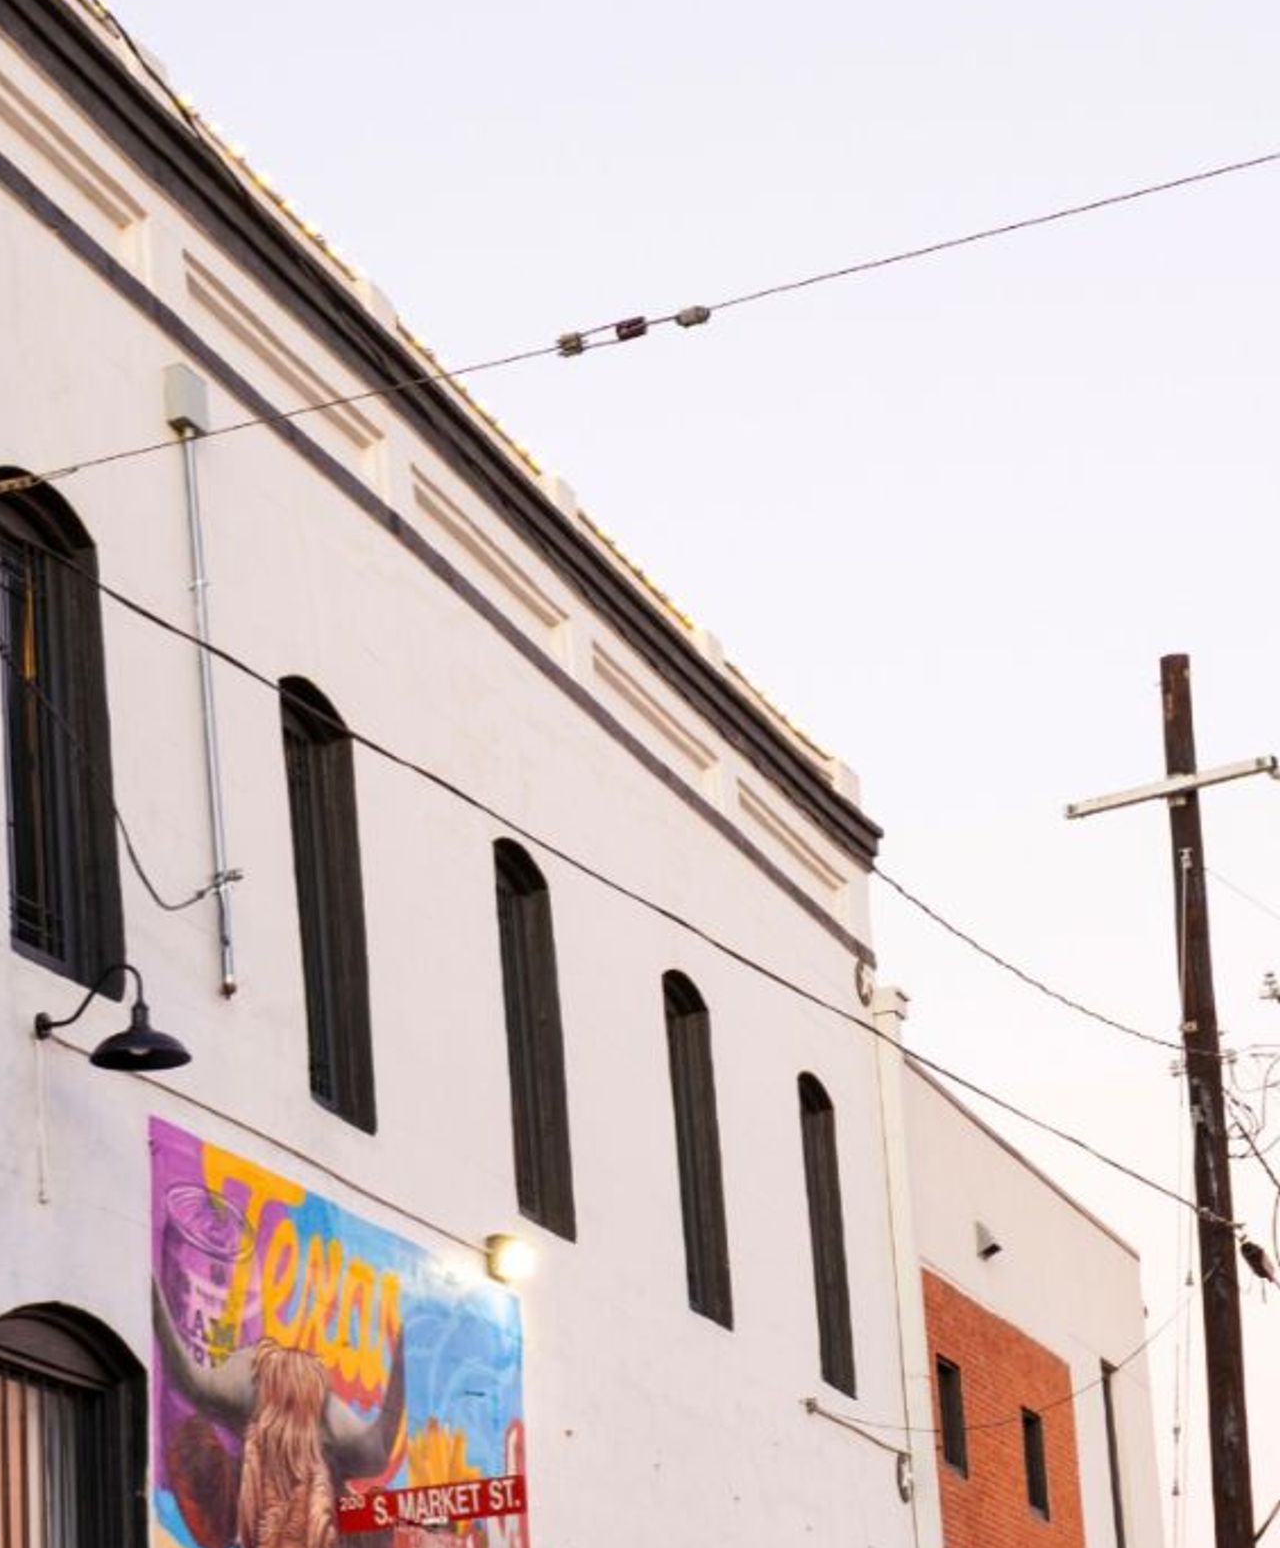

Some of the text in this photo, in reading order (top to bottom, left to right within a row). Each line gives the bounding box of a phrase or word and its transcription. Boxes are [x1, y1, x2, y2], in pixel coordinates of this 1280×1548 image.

[373, 1495, 393, 1526] S.
[397, 1483, 481, 1521] MARKET
[488, 1478, 522, 1510] ST.
